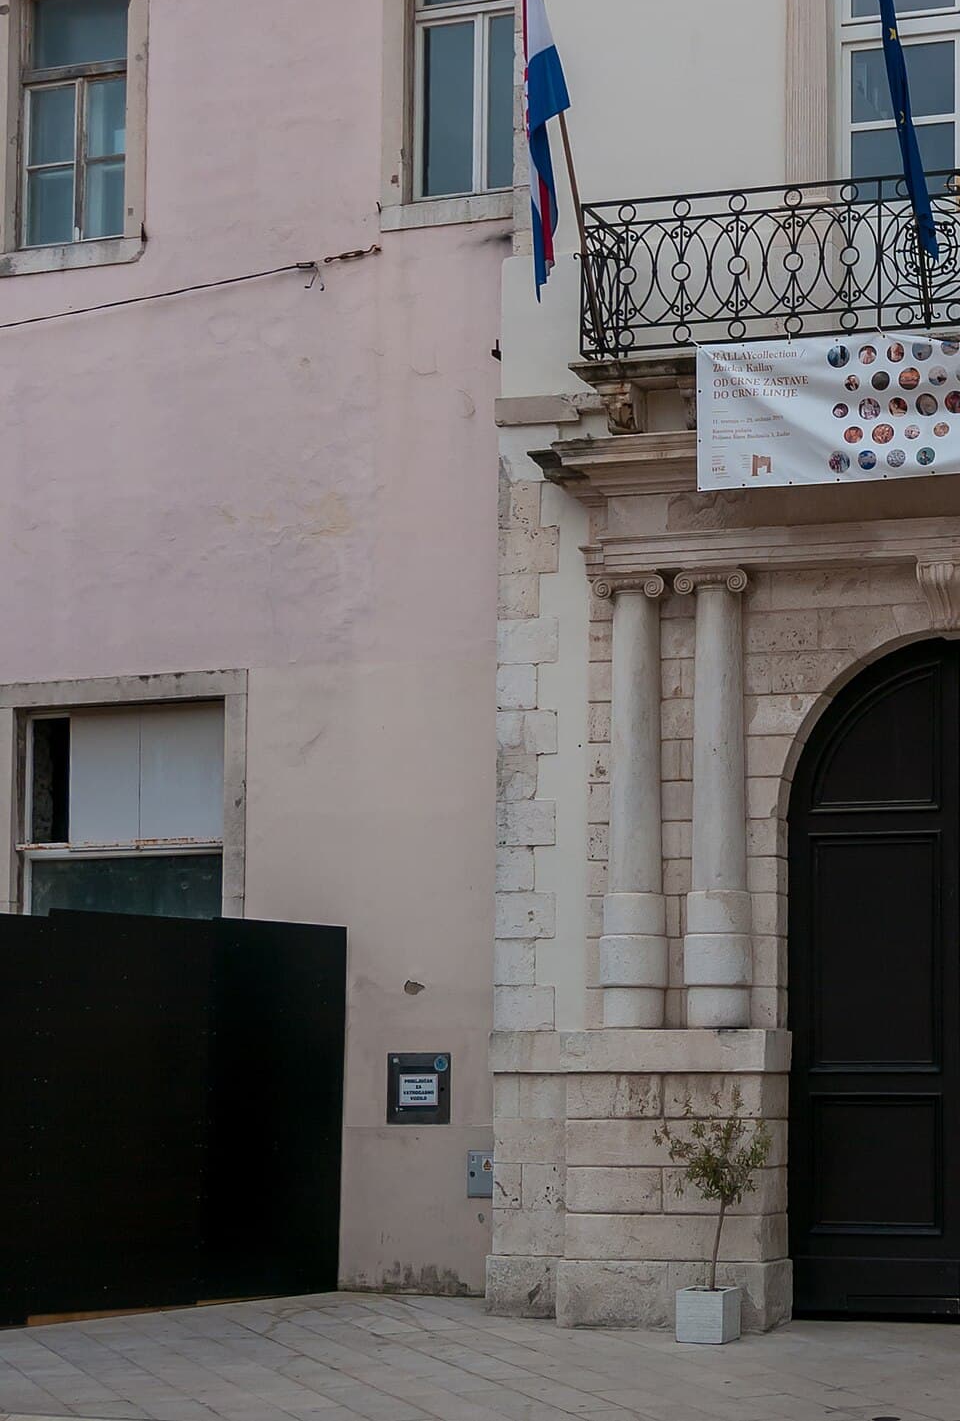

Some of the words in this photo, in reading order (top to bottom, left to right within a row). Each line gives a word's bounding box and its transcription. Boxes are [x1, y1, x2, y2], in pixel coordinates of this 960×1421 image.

[746, 362, 774, 373] Kallay
[713, 378, 729, 387] OD
[730, 376, 760, 386] CRNE
[763, 375, 808, 386] ZASTAVE
[713, 390, 729, 399] DO
[731, 388, 759, 398] CRNE
[762, 388, 798, 398] LINIJE
